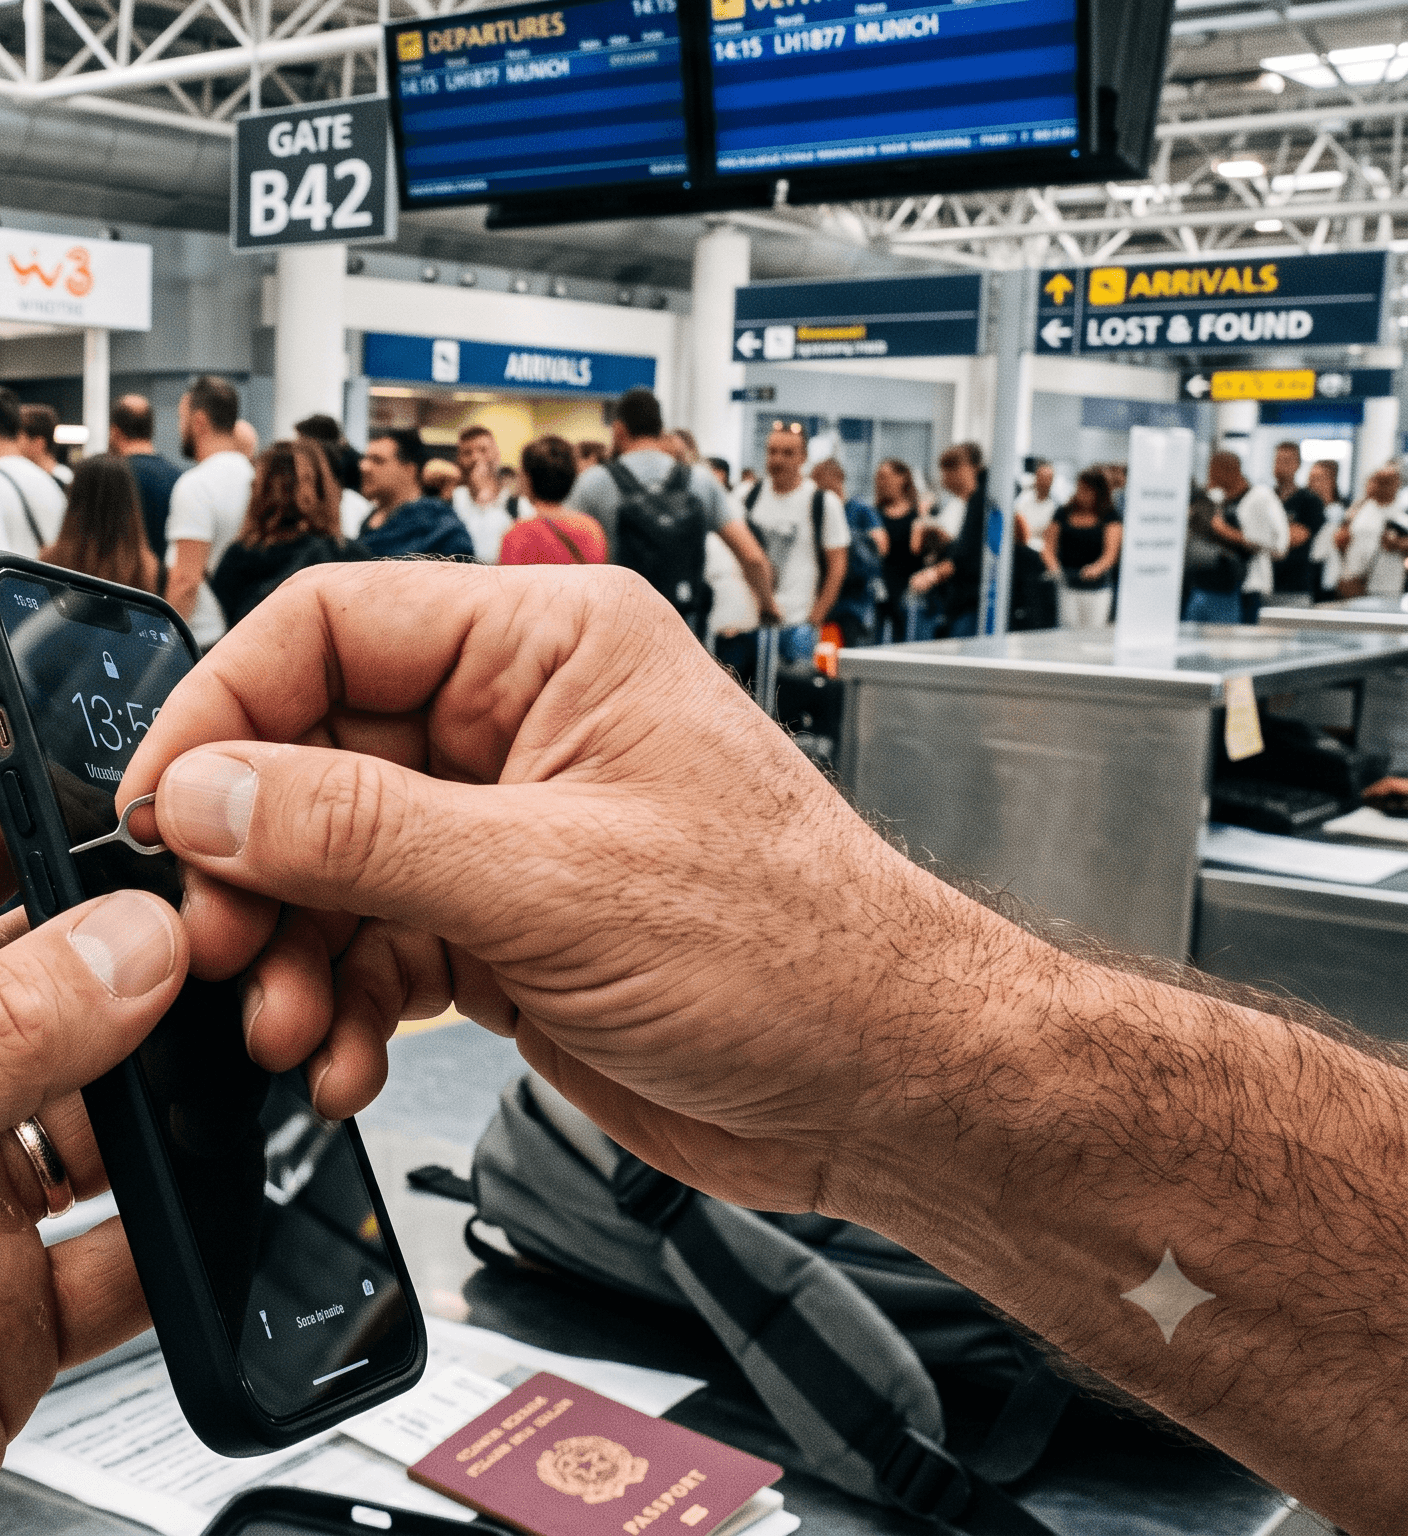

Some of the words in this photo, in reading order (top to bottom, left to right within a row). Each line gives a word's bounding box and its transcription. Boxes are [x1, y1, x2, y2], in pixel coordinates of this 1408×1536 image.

[427, 12, 566, 54] DEPARTURES
[714, 36, 763, 61] 14:15
[855, 14, 939, 44] MUNICH
[268, 113, 353, 158] GATE
[250, 158, 373, 237] B42
[1129, 264, 1279, 297] ARRIVALS
[1087, 315, 1163, 346] LOST
[1167, 314, 1192, 344] &
[1198, 310, 1313, 342] FOUND
[72, 692, 161, 751] 13:5
[623, 1469, 707, 1536] PASSPORT
